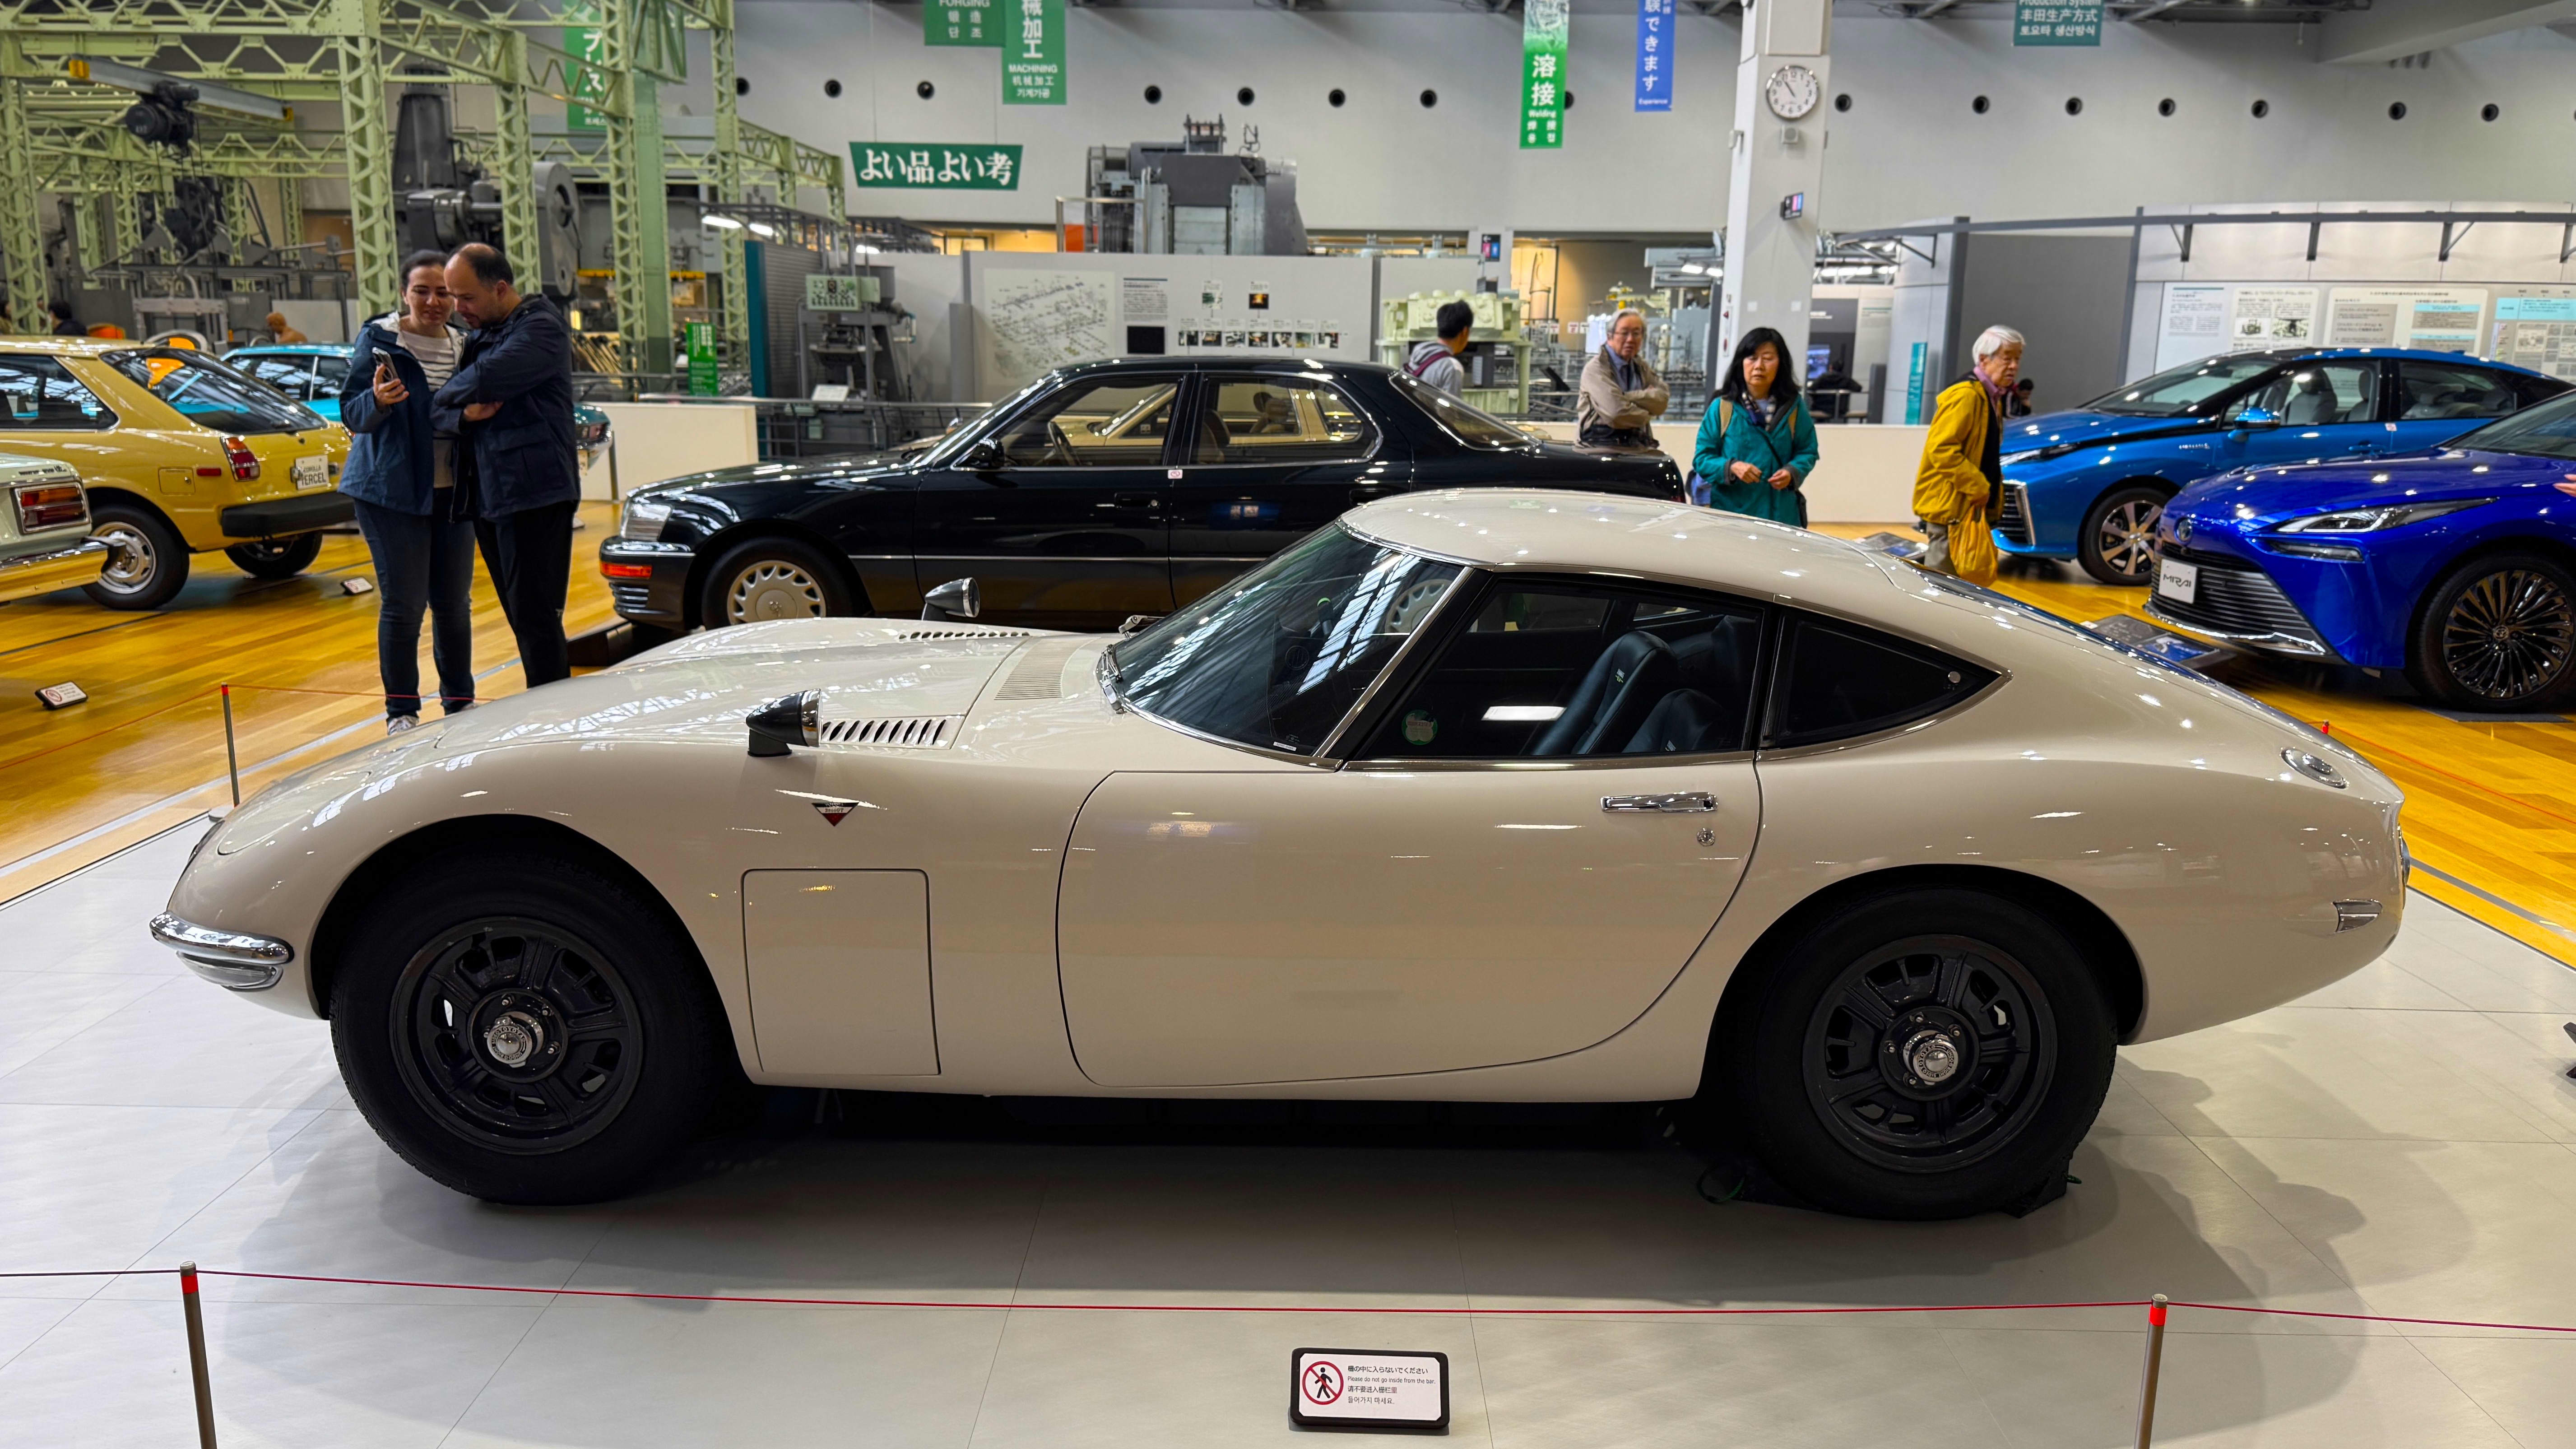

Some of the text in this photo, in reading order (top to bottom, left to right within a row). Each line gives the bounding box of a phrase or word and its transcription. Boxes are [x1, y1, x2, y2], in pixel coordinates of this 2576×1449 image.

[2020, 8, 2098, 22] 丰田生产方式
[2020, 25, 2051, 36] 토요타
[1008, 64, 1058, 74] MACHINING
[1532, 53, 1556, 106] 溶接
[1528, 109, 1556, 118] Welding
[860, 148, 1013, 186] よい品よい考
[2163, 574, 2191, 587] MIRAI
